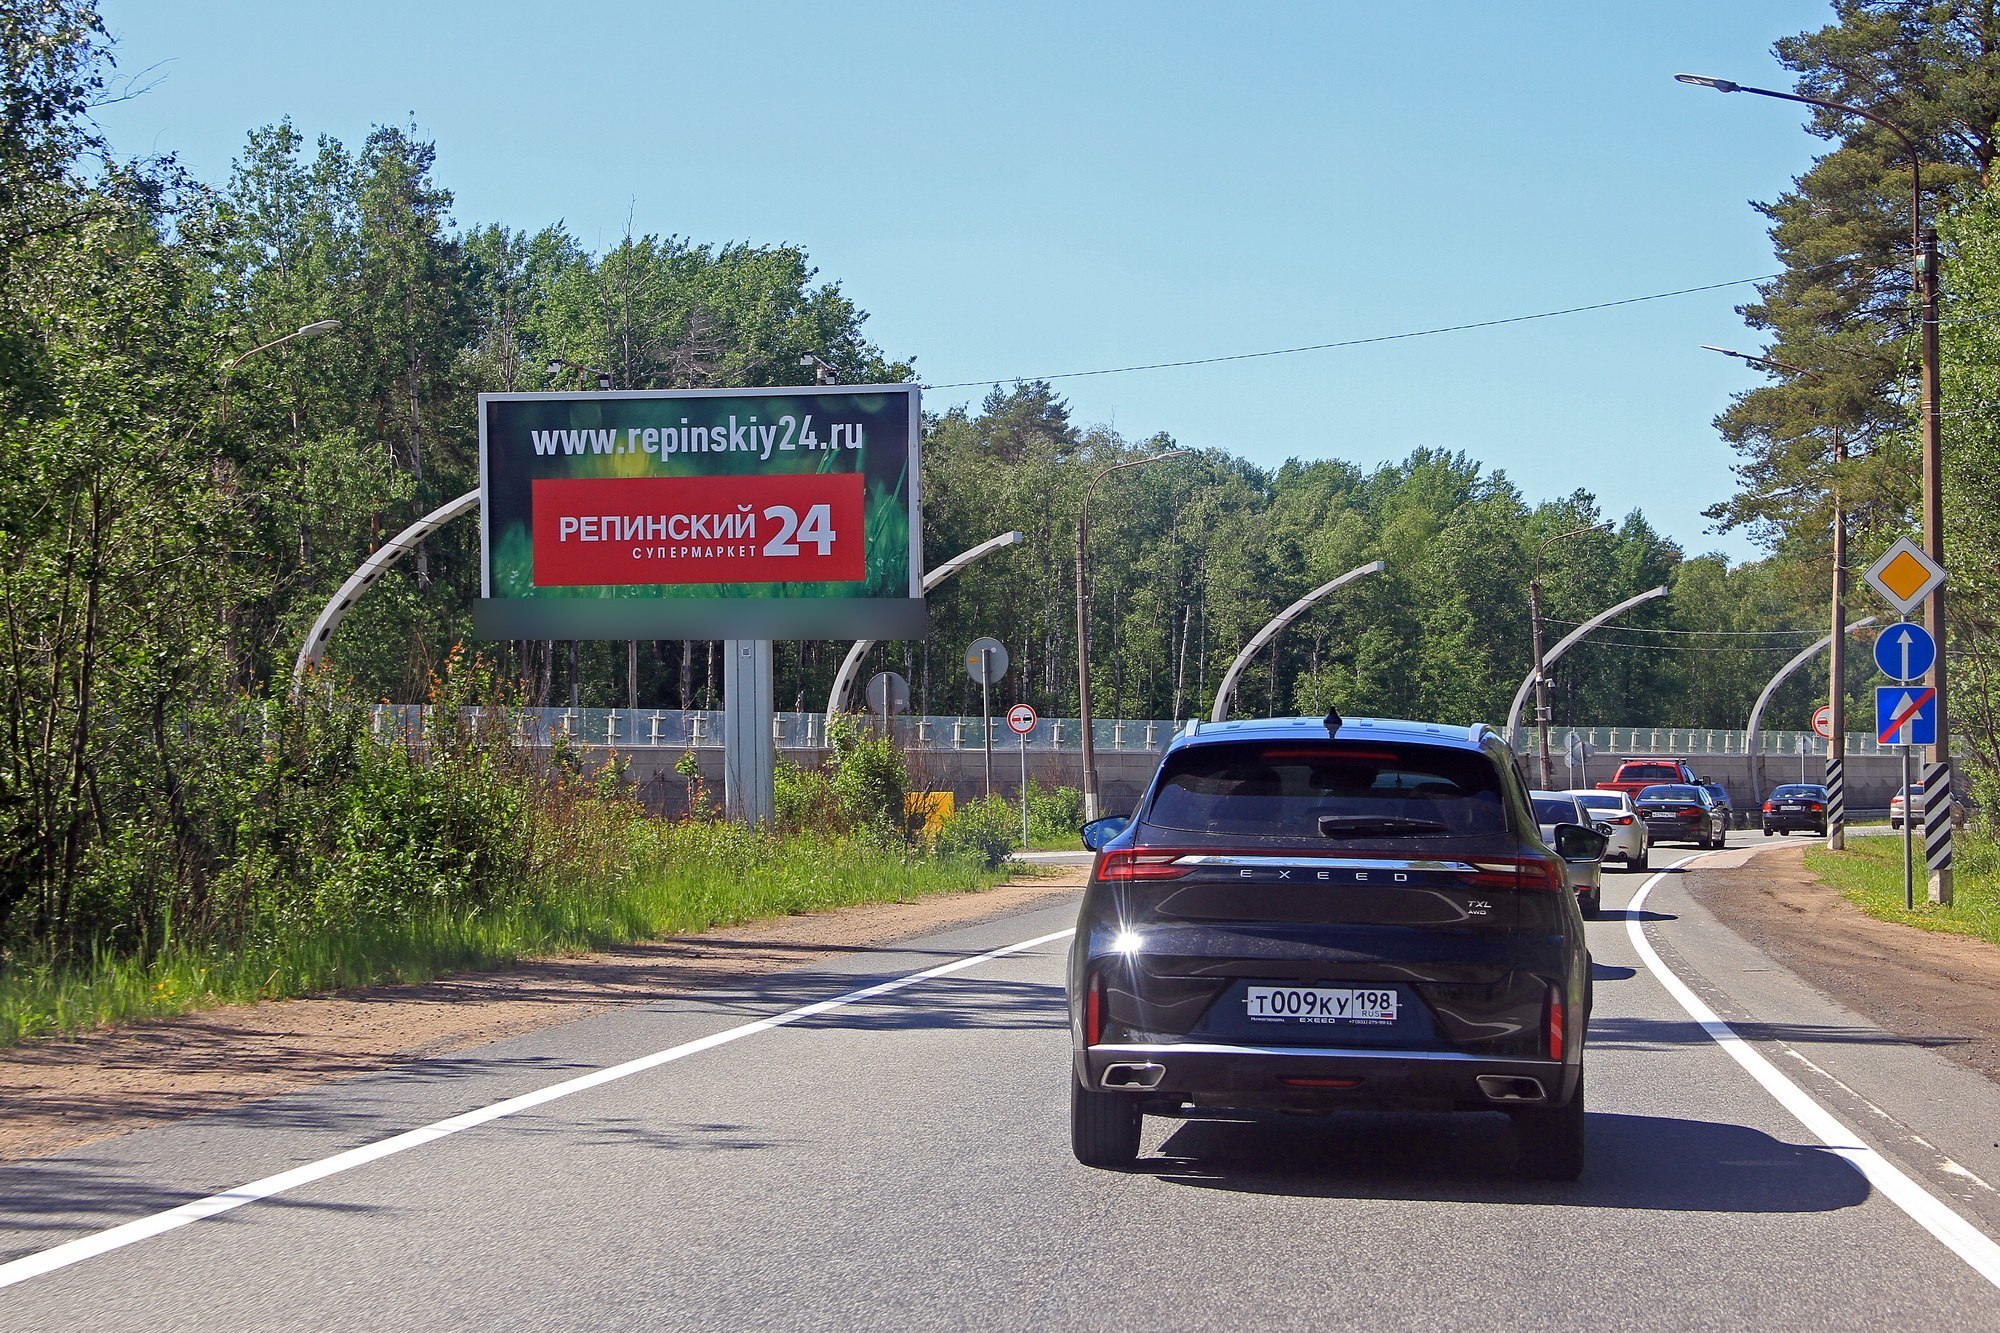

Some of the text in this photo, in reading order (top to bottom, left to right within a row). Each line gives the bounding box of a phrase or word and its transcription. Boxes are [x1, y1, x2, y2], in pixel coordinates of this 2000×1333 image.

[531, 415, 863, 461] www.repinskiy24.ru
[559, 503, 837, 557] РЕПИНСКИЙ 24
[632, 545, 757, 560] СУПЕРМАРКЕТ
[1240, 869, 1408, 882] EXEED
[1468, 900, 1492, 909] TXL
[1355, 991, 1391, 1010] 198
[1361, 1010, 1380, 1018] RUS
